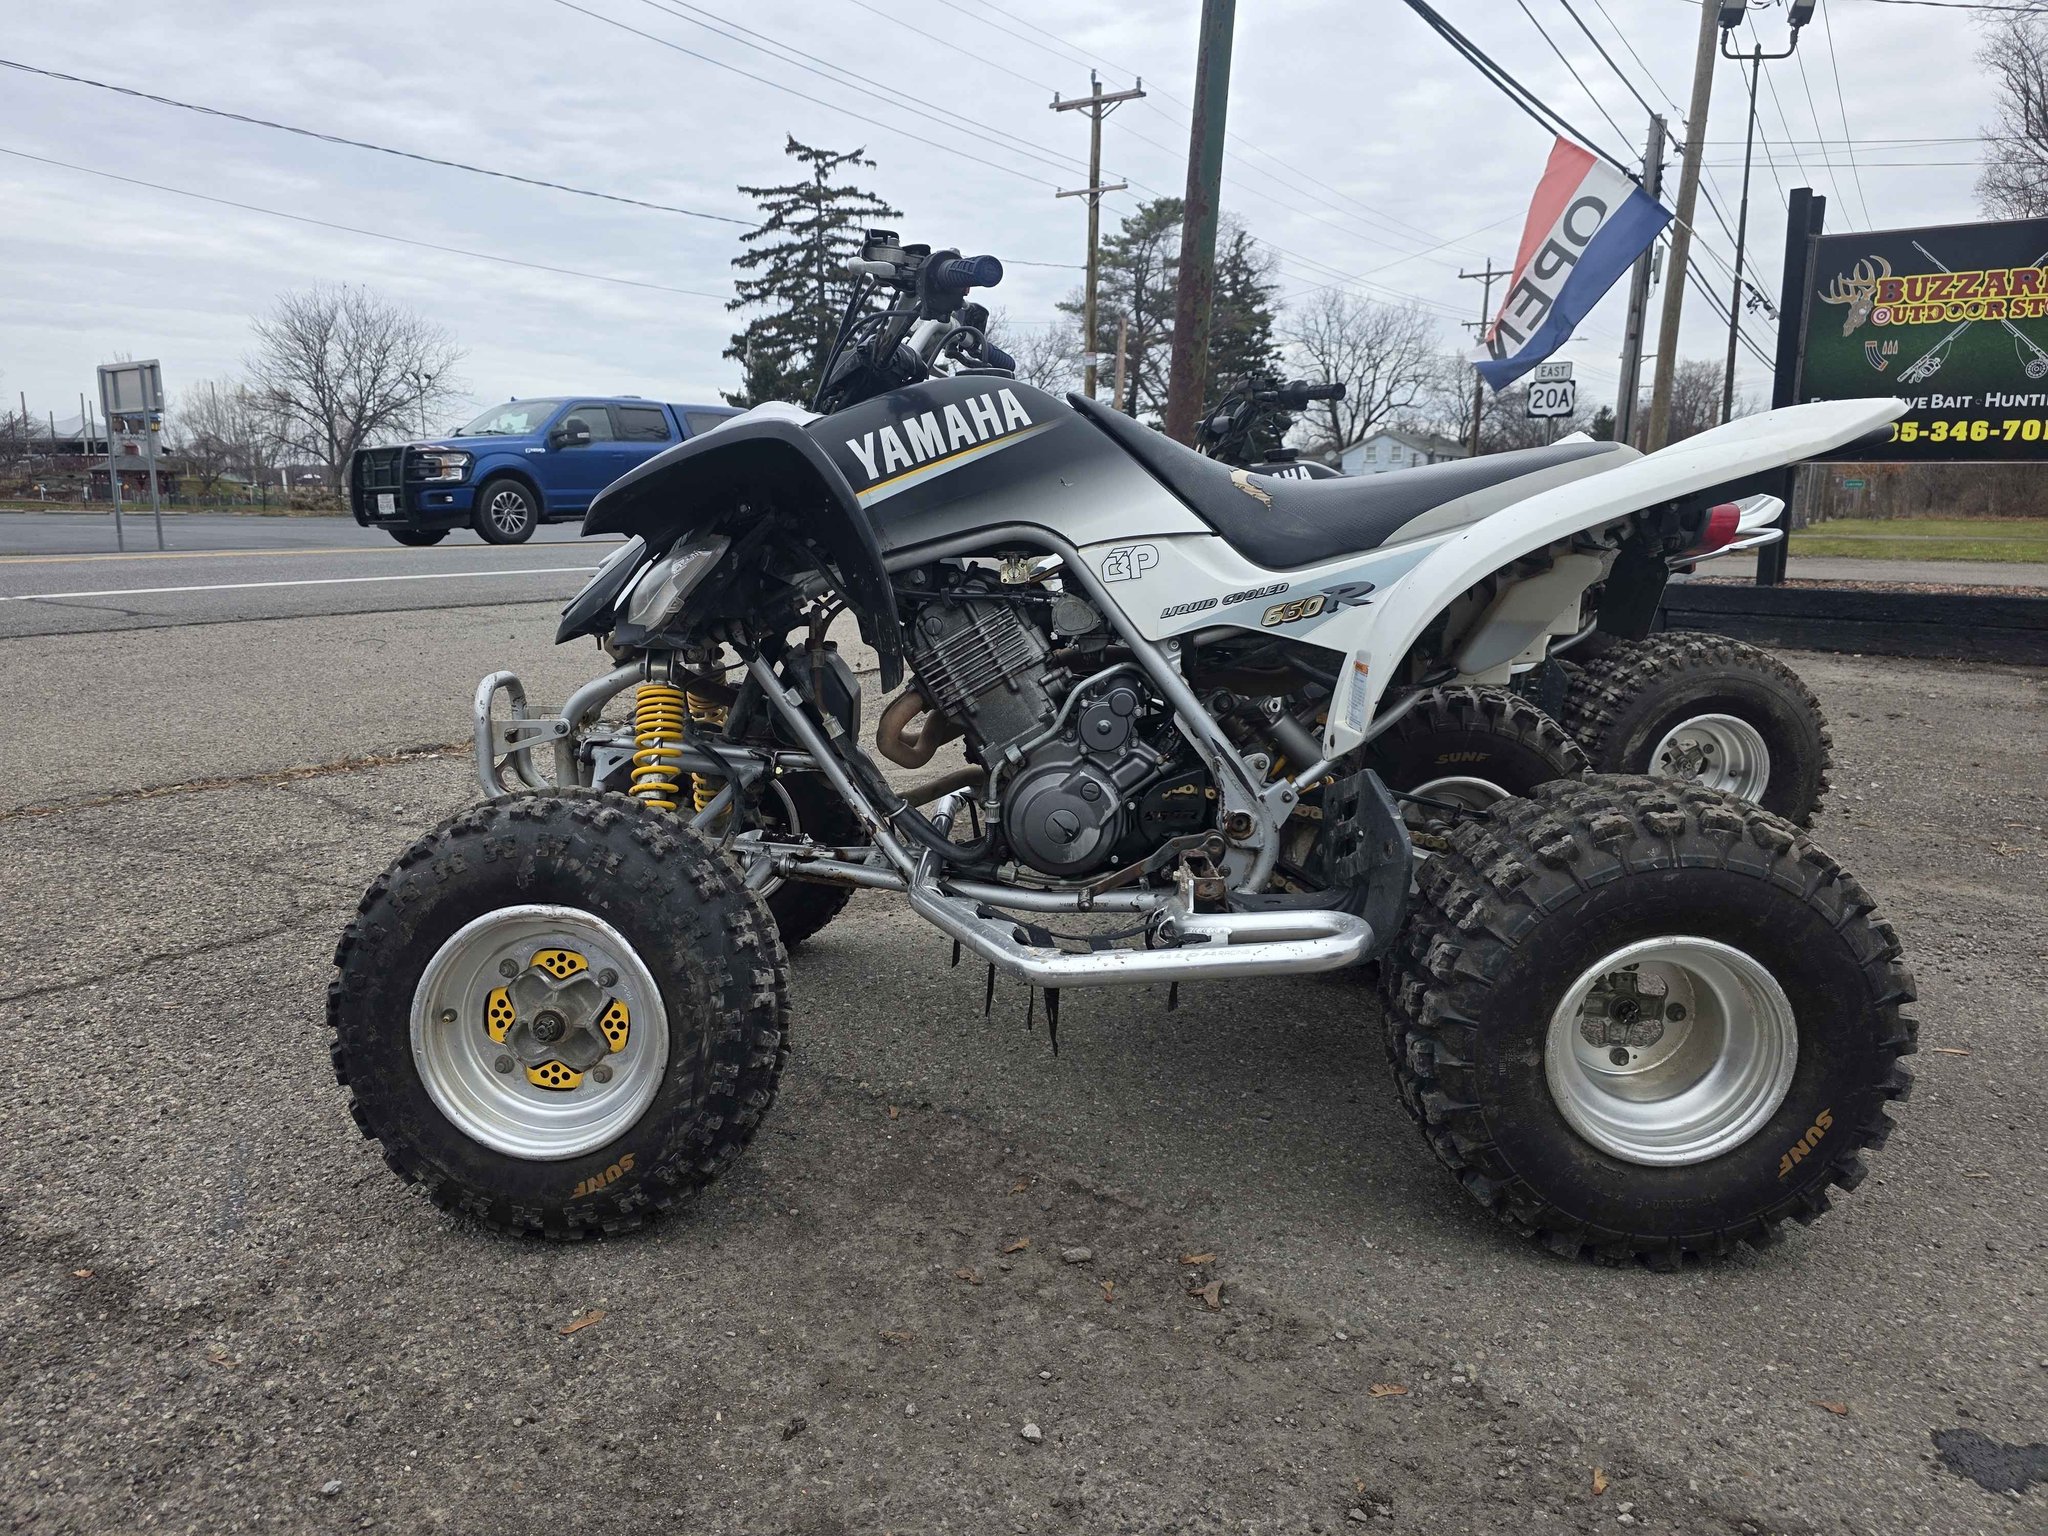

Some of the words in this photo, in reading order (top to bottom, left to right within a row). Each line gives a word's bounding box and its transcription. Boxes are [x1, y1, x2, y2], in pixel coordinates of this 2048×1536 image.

[1875, 267, 2048, 305] BUZZAR
[1871, 299, 2007, 326] OUTDOOR
[2009, 296, 2048, 320] ST
[1540, 366, 1566, 377] EAST
[1532, 388, 1569, 408] 20A
[1892, 395, 1928, 409] VE
[1930, 393, 1973, 409] BAIT
[1985, 391, 2048, 408] HUNTI
[846, 387, 1033, 480] YAMAHA
[1160, 598, 1218, 619] LIQUID
[1222, 583, 1289, 605] COOLED
[1434, 751, 1492, 764] SUNF
[1777, 1107, 1834, 1179] SUNF
[568, 1152, 636, 1200] SUNF
